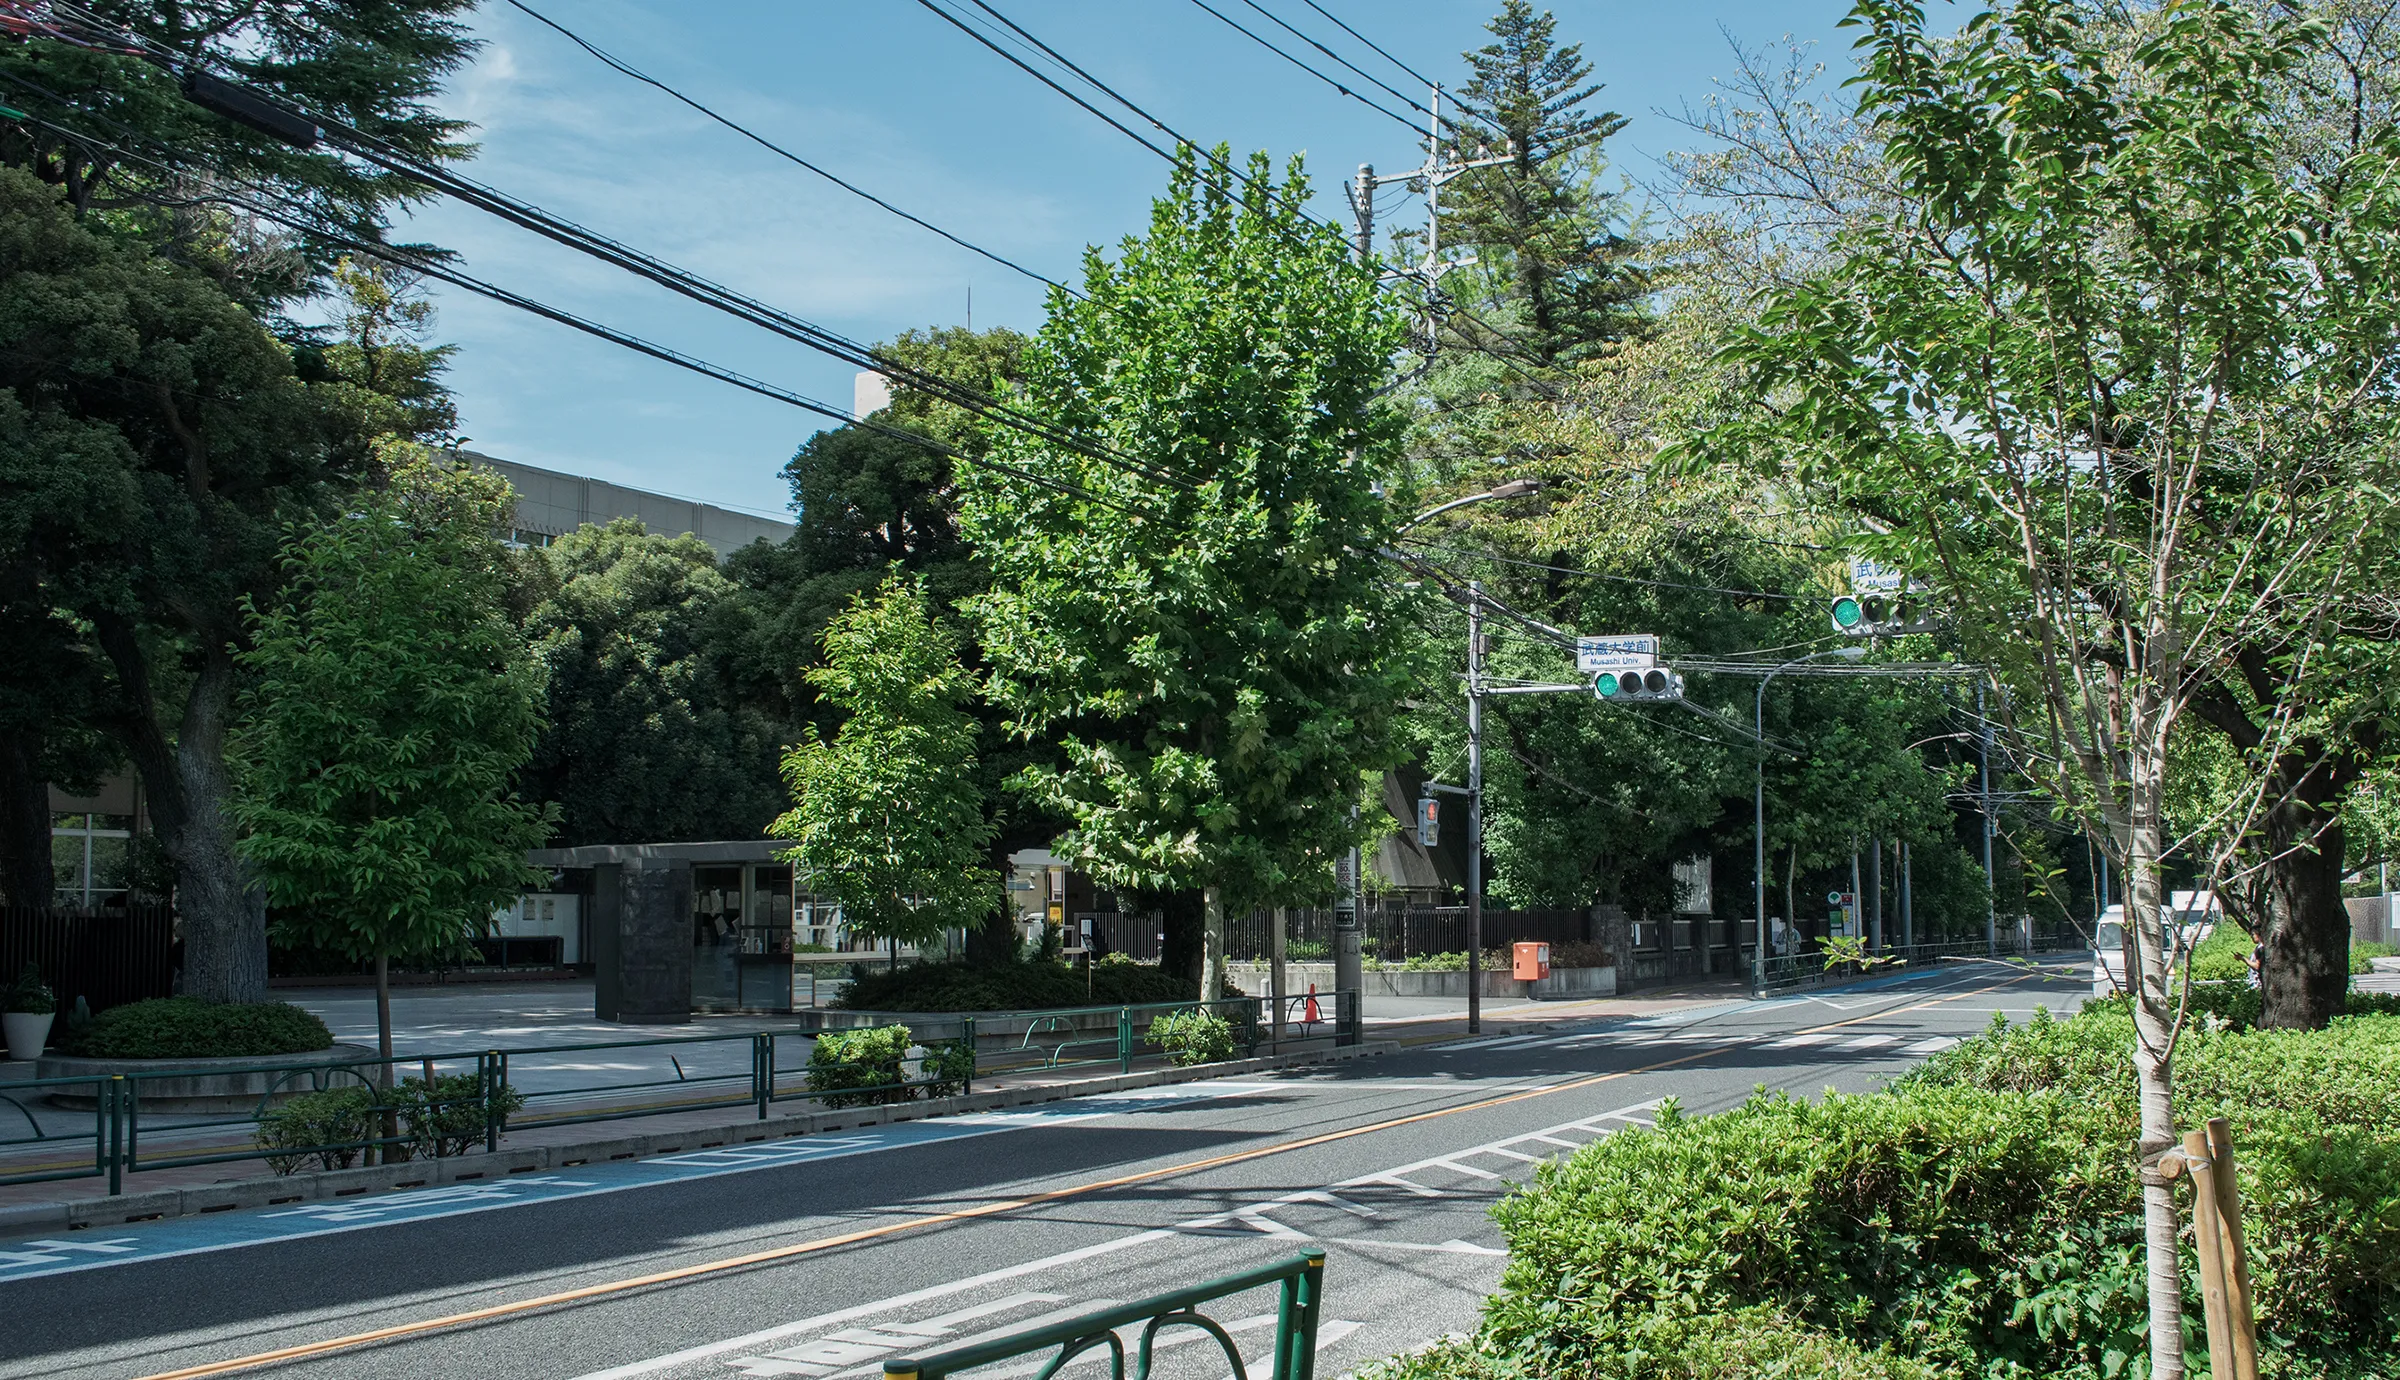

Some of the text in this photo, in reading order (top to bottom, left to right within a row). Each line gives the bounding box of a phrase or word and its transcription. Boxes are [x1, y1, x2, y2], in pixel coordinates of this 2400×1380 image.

[1582, 640, 1650, 656] 武蔵大学前
[1590, 657, 1641, 666] Musashi Univ.
